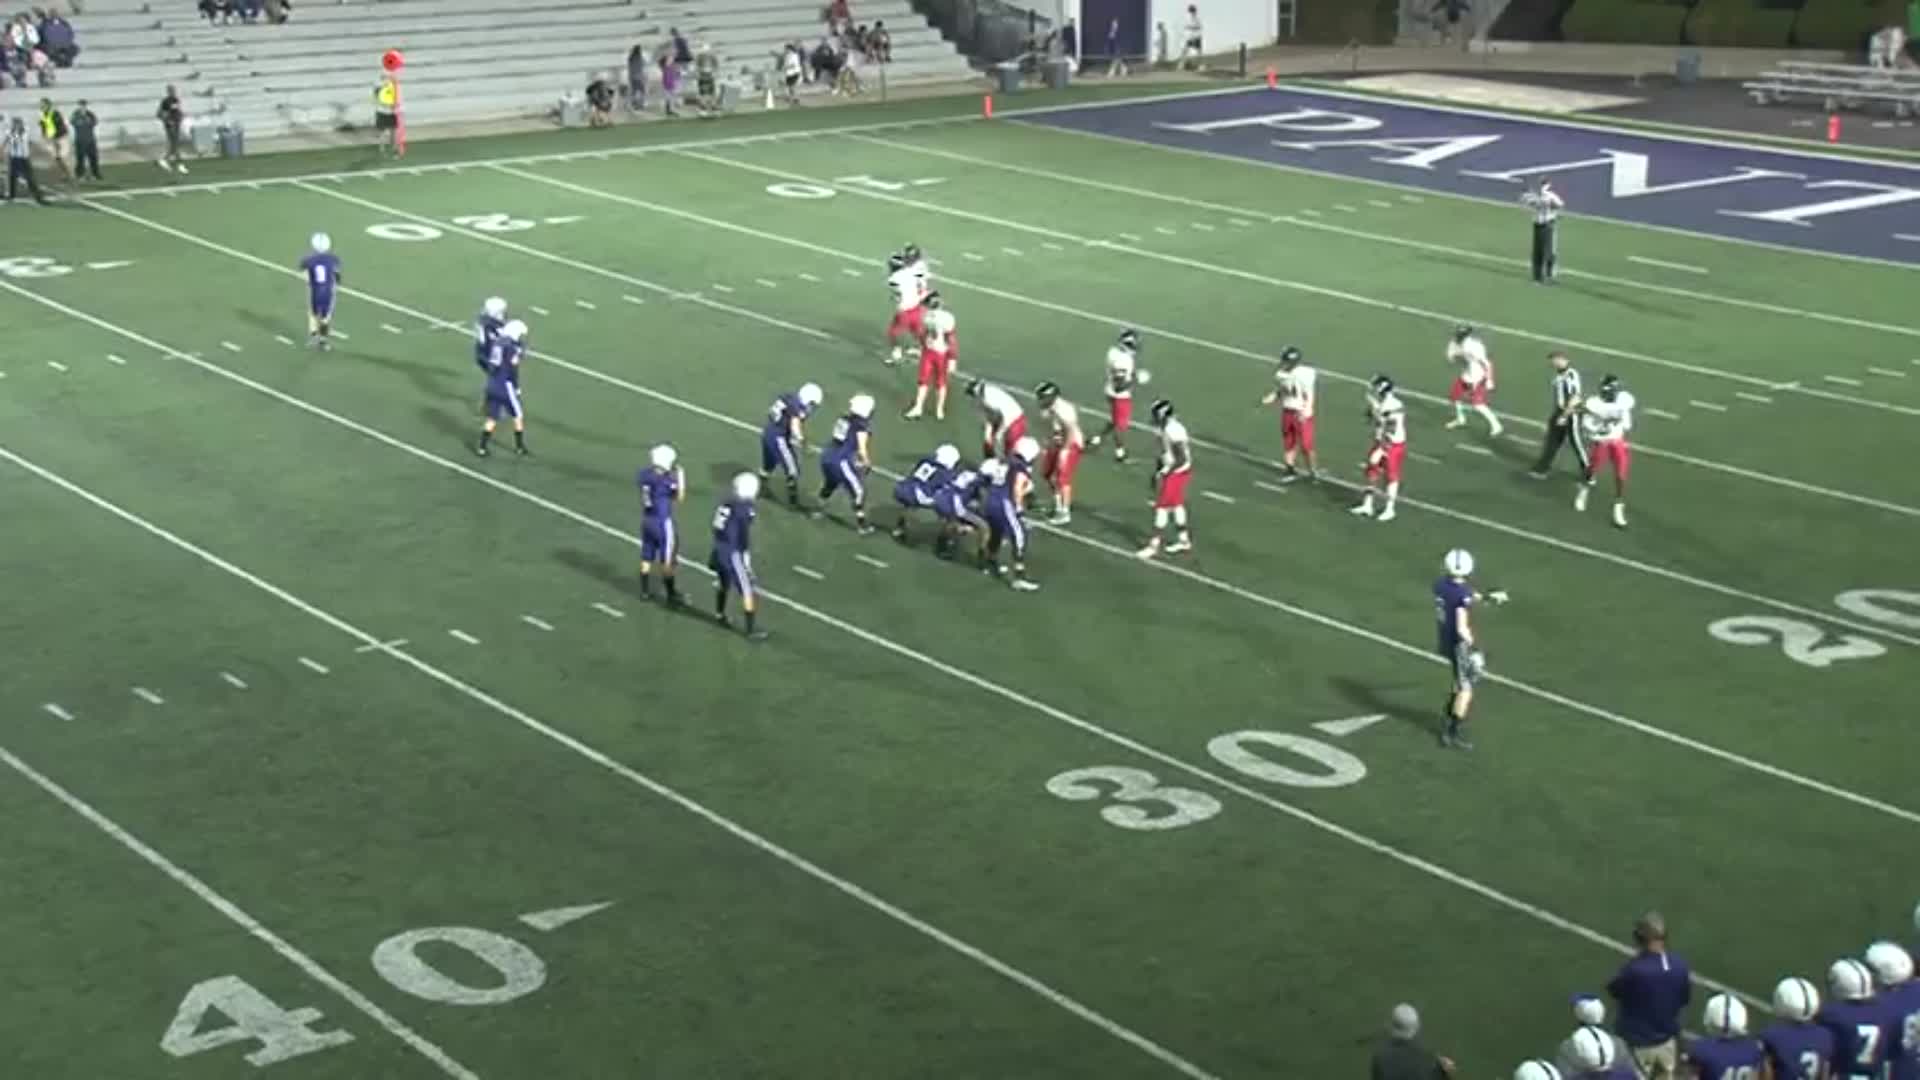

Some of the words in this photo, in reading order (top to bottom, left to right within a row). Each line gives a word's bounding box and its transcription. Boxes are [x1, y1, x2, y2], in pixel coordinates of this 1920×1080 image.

[365, 213, 536, 241] 20
[1045, 730, 1367, 829] 30
[161, 926, 547, 1067] 40
[1856, 1024, 1880, 1063] 7
